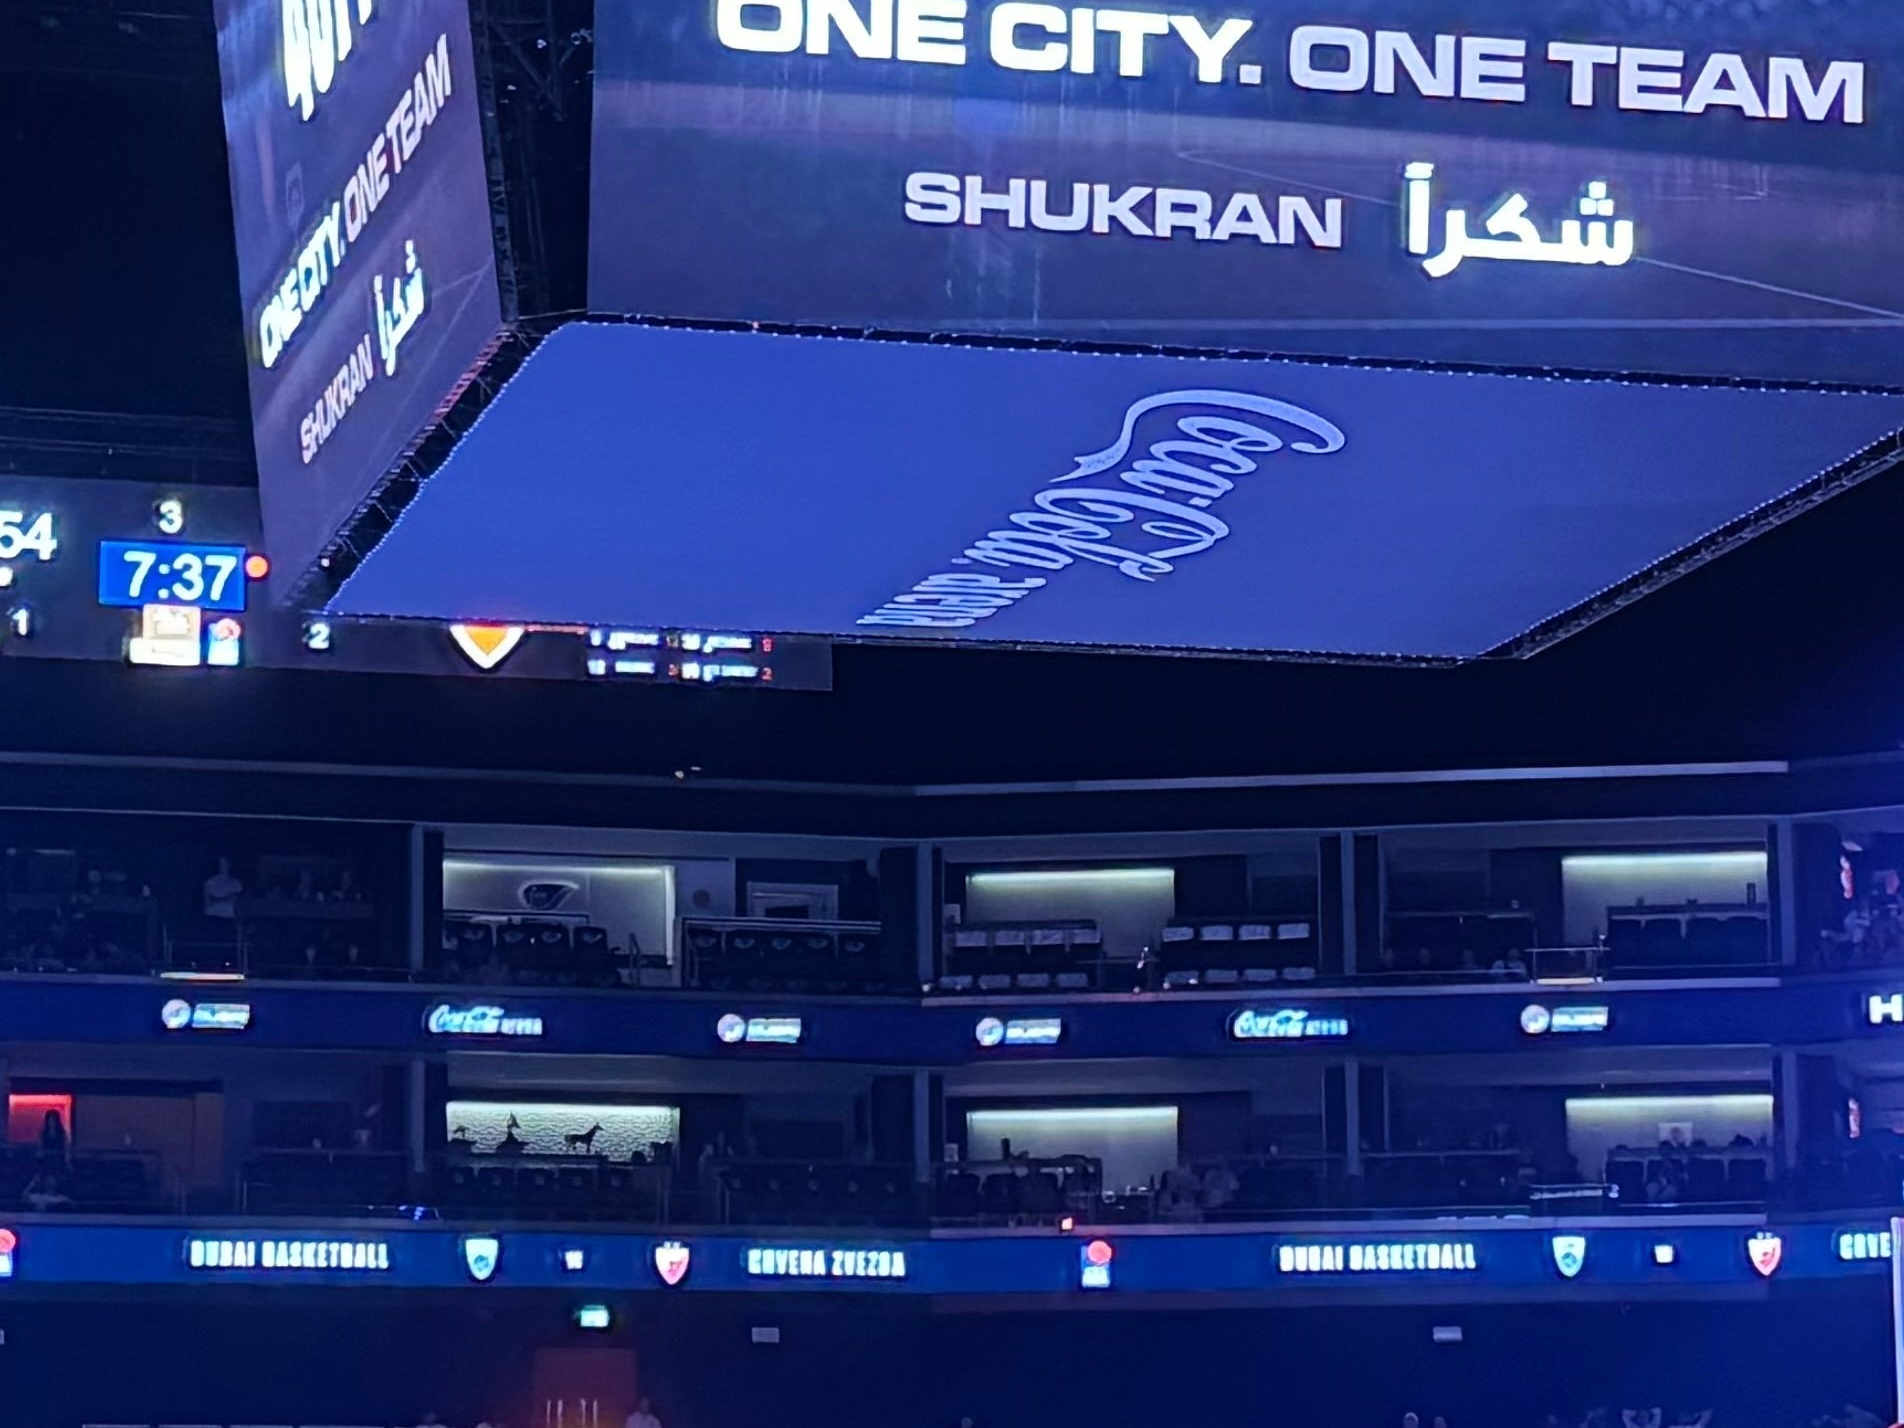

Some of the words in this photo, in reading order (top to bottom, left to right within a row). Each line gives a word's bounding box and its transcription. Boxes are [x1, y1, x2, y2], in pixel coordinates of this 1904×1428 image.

[990, 2, 1261, 83] CITY.
[1290, 26, 1525, 101] ONE
[1548, 42, 1863, 123] TEAM
[342, 150, 390, 246] ONE
[386, 32, 452, 190] TEAM
[905, 172, 1341, 247] SHUKRAN
[300, 334, 373, 464] SHUKRAN
[159, 500, 183, 533] 3
[124, 551, 237, 600] 7:37
[309, 623, 329, 648] 2
[262, 1241, 388, 1268] BASKETBALL
[1349, 1244, 1475, 1270] BASKETBALL
